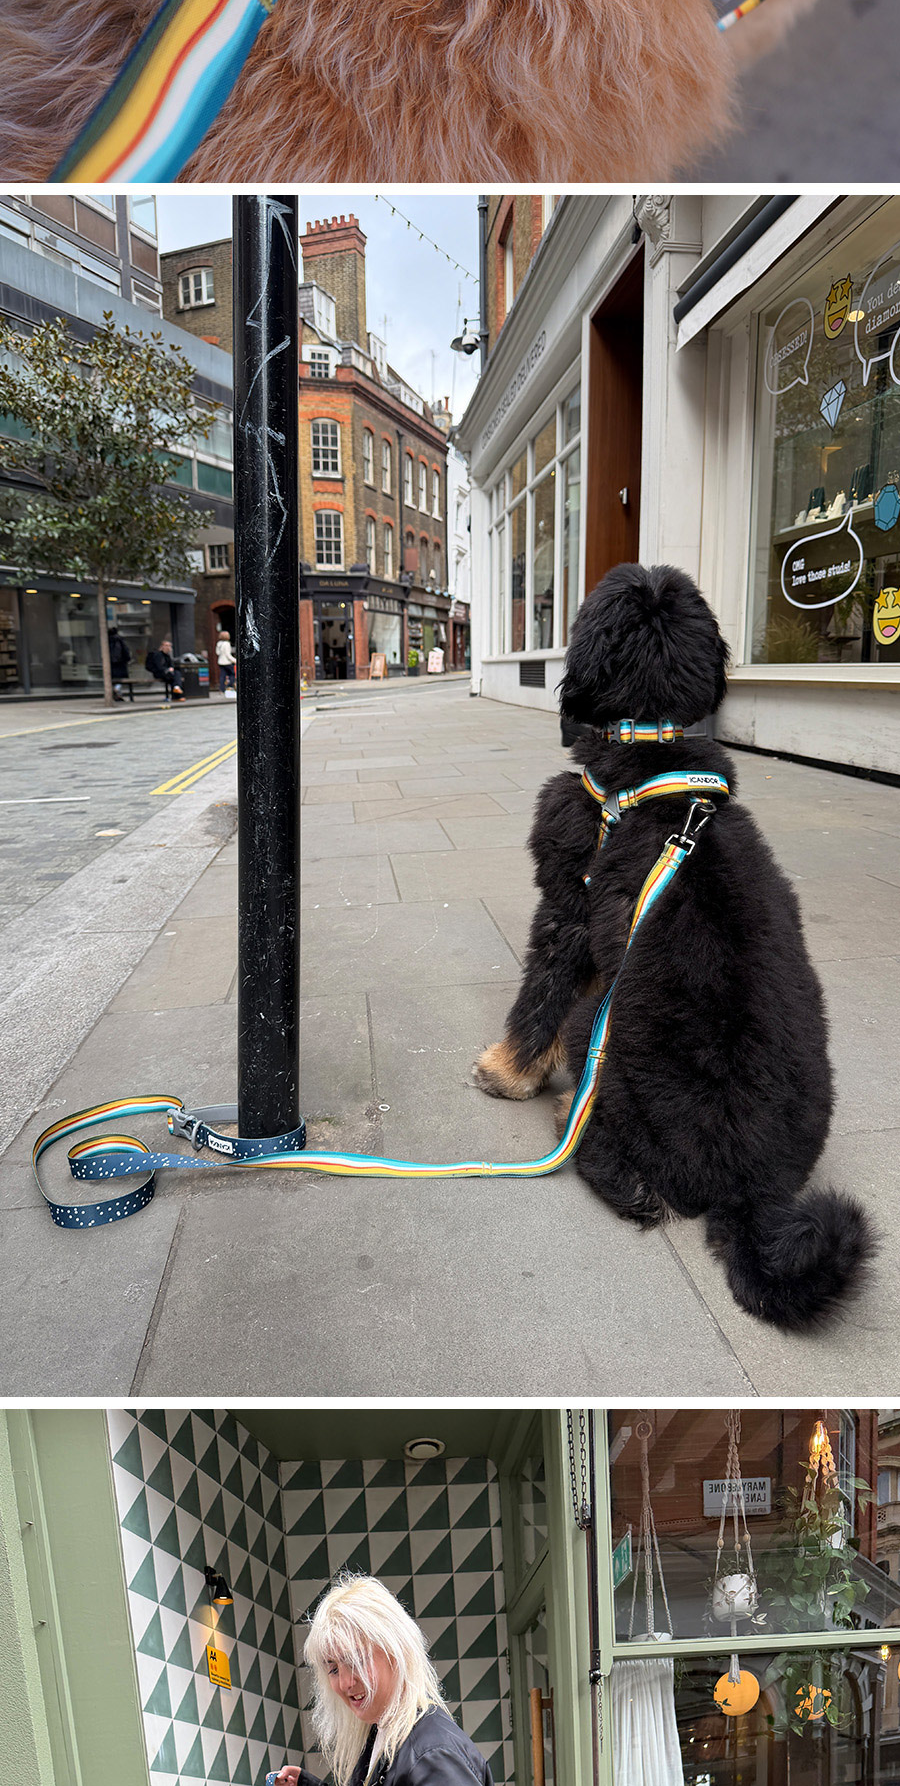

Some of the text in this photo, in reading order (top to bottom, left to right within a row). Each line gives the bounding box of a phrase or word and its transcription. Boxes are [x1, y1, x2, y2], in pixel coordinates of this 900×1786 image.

[867, 282, 900, 314] You de
[791, 575, 807, 587] love
[807, 569, 827, 583] those
